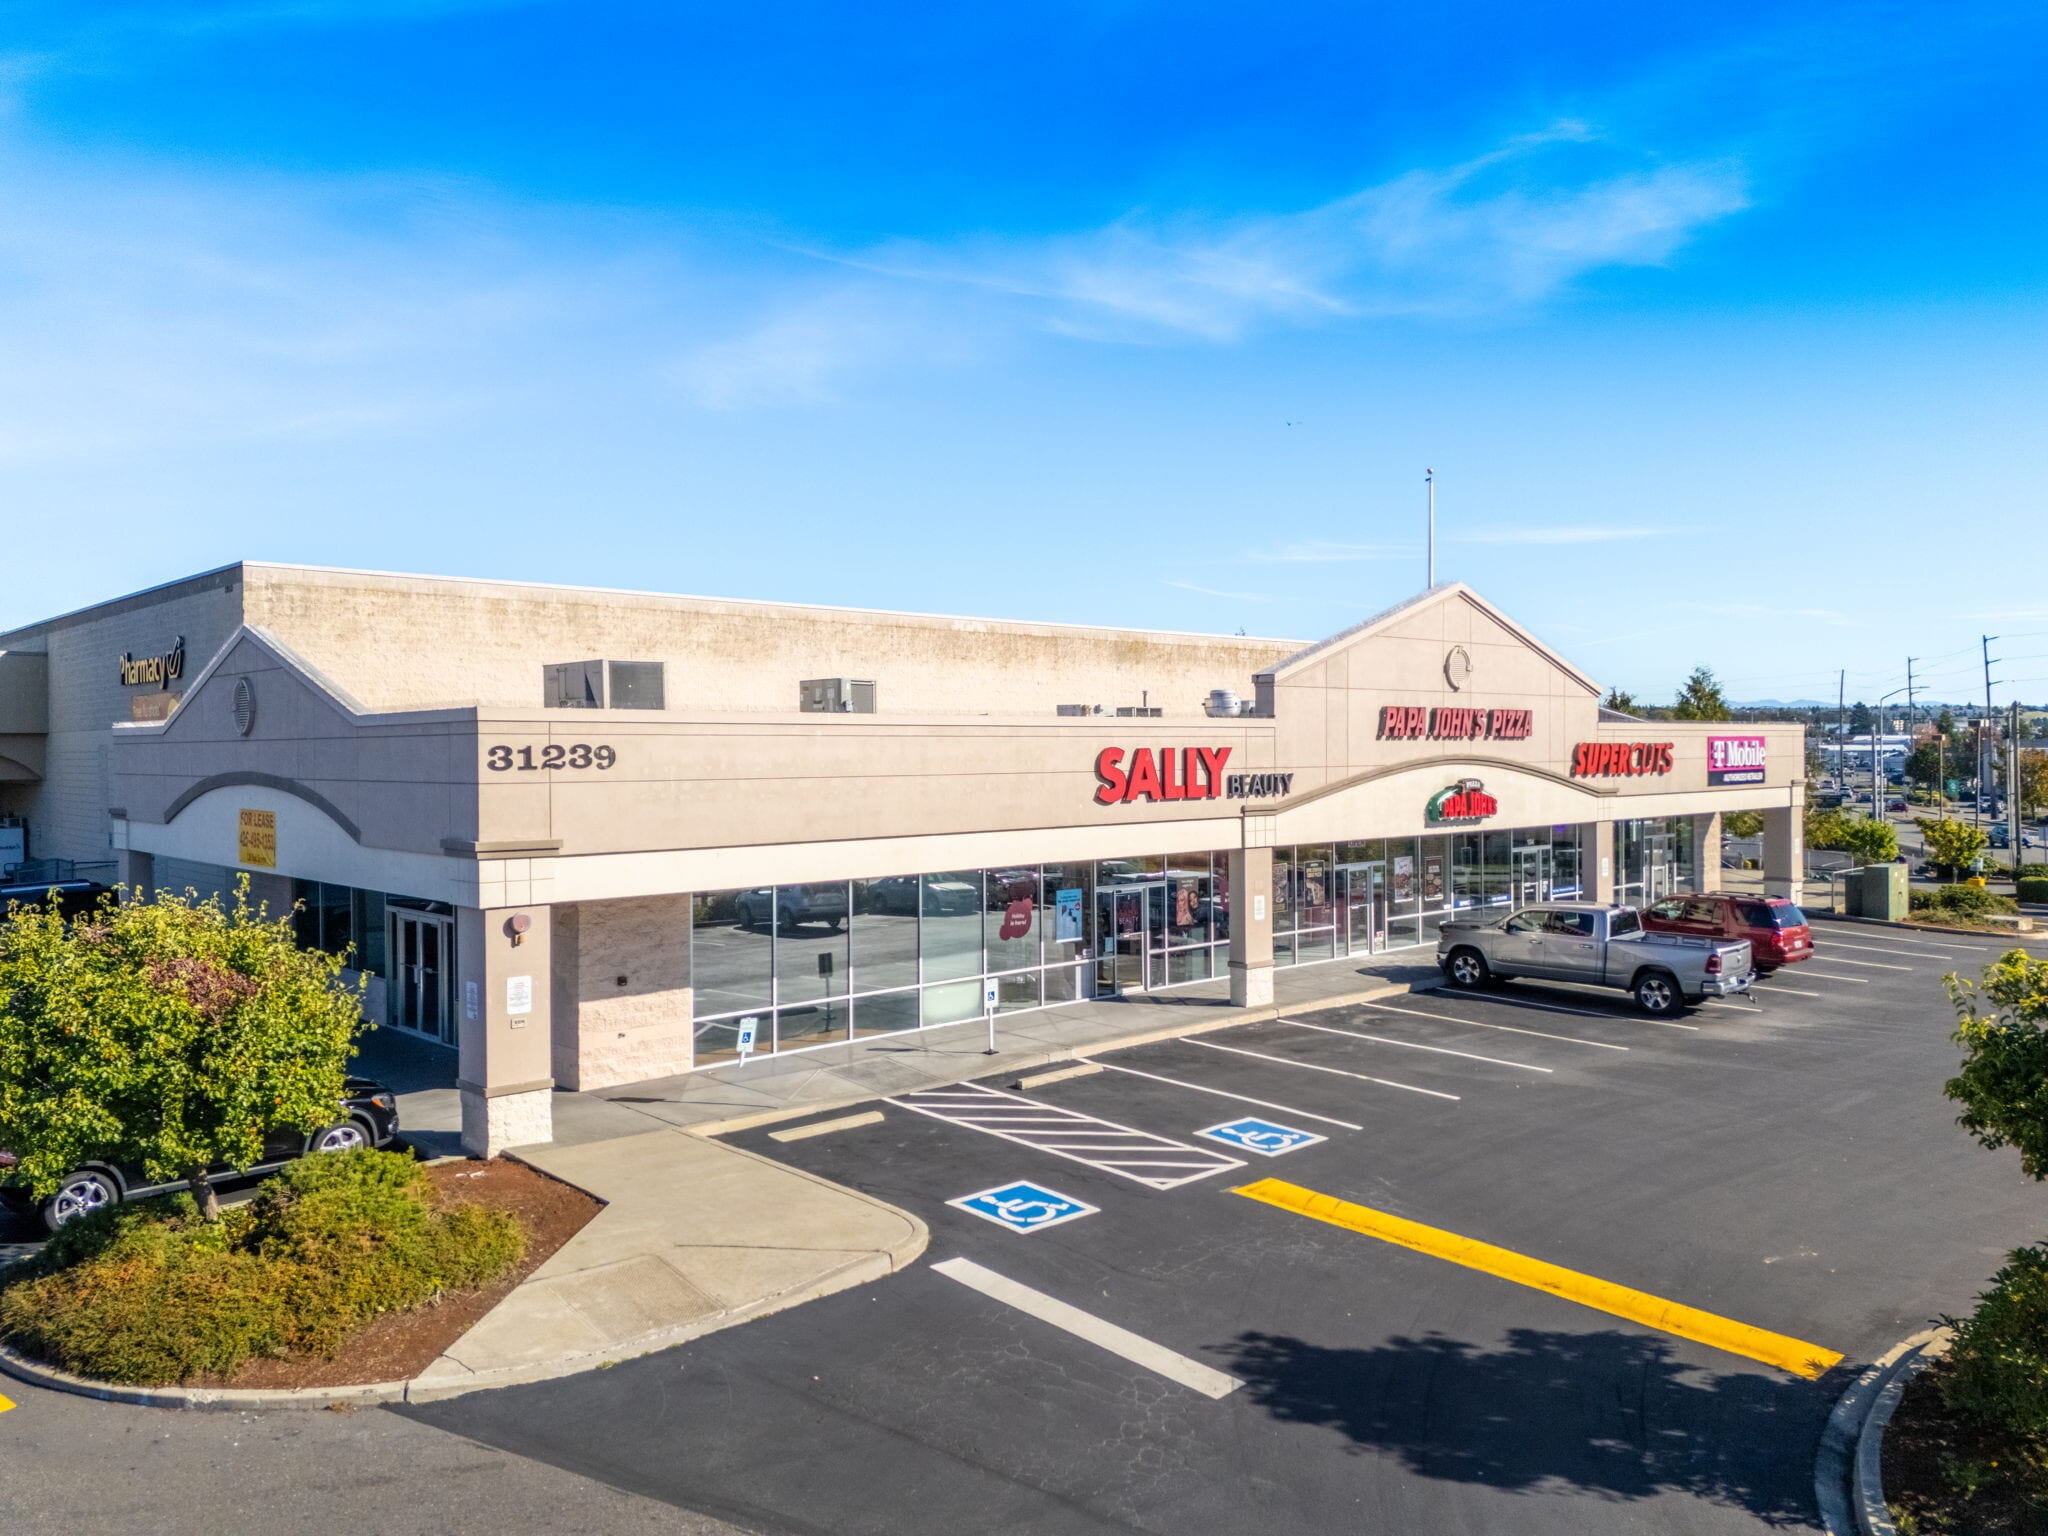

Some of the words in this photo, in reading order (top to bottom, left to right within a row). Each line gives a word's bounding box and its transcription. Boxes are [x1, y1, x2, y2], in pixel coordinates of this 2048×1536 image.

[120, 652, 167, 690] Pharmacy
[1380, 706, 1427, 738] PAPA
[1429, 708, 1487, 739] JOHN'S
[1487, 709, 1533, 739] PIZZA
[487, 744, 616, 771] 31239
[1572, 742, 1674, 776] SUPERCUTS
[1726, 741, 1766, 767] Mobile
[1095, 746, 1233, 805] SALLY
[1228, 773, 1294, 798] BEAUTY
[240, 811, 252, 826] FOR
[253, 813, 274, 828] LEASE
[1443, 792, 1469, 818] PAPA
